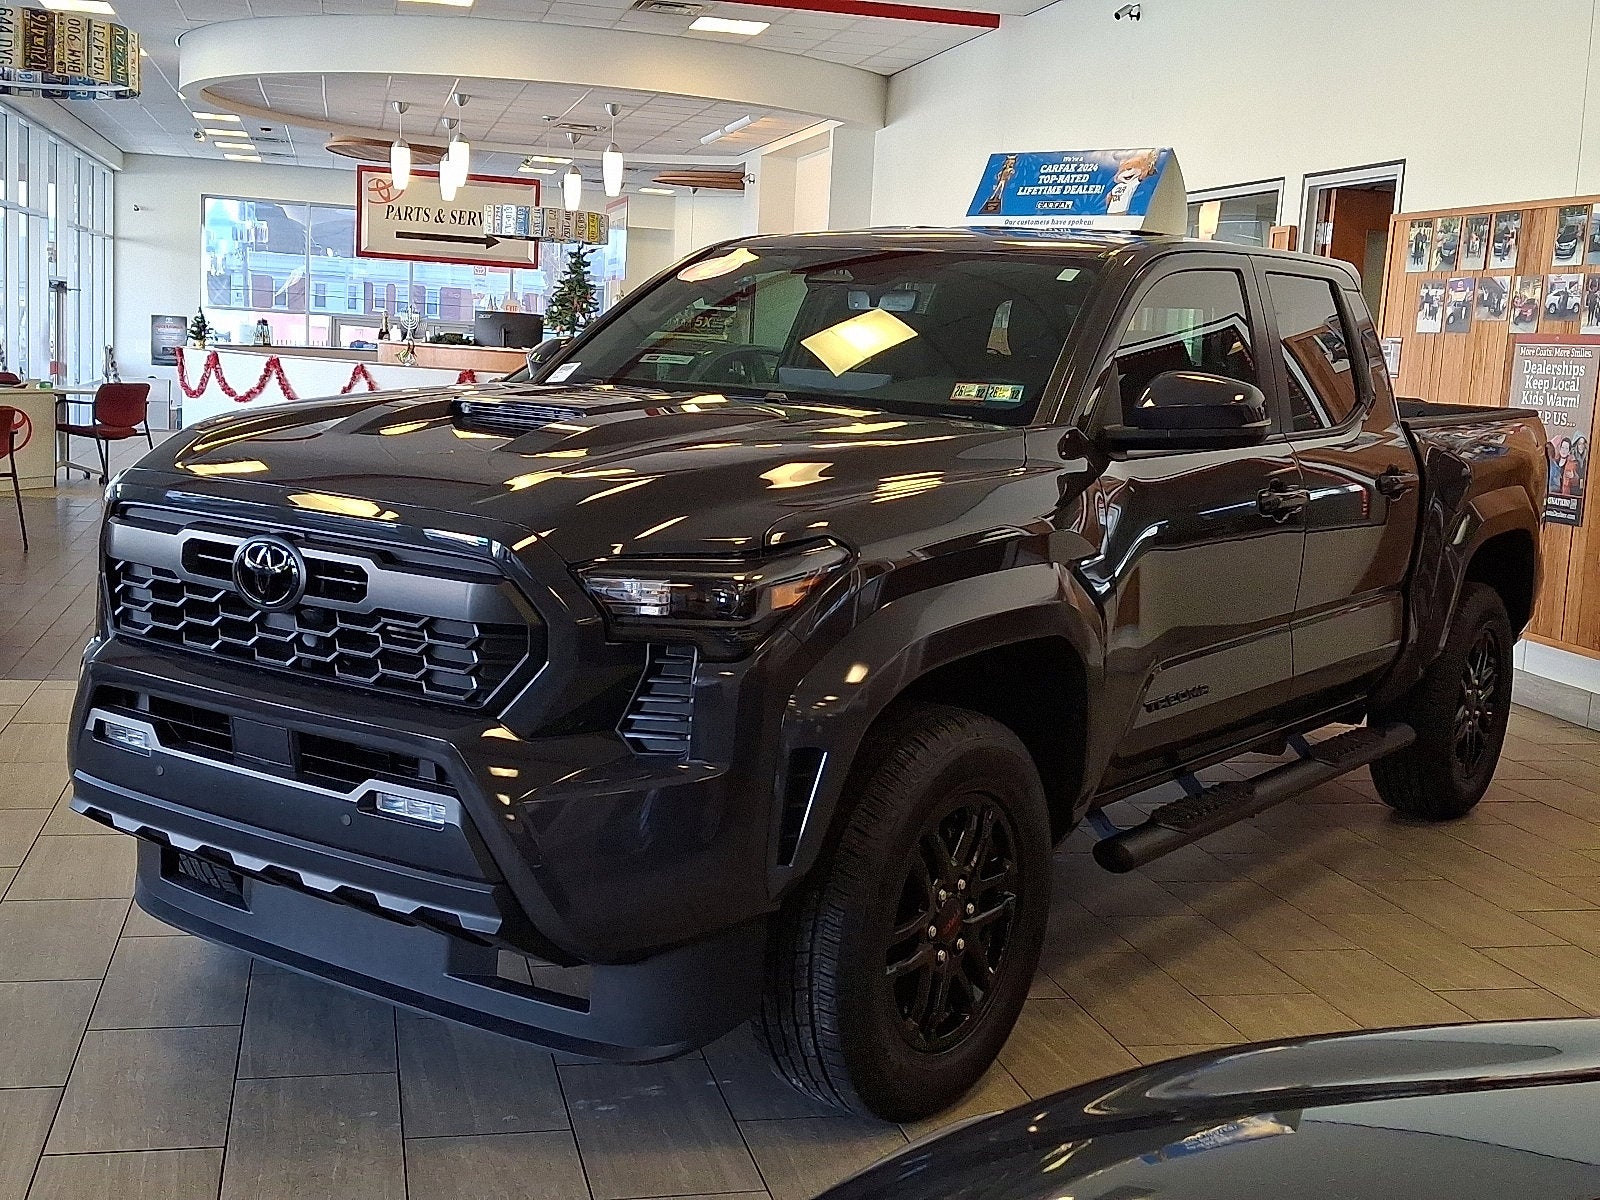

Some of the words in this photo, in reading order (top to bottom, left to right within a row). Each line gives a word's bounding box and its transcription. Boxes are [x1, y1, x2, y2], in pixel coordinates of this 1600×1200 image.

[31, 13, 48, 35] 476
[67, 18, 81, 42] 900
[93, 24, 106, 77] YCA-4731
[67, 48, 81, 73] BKM
[1040, 164, 1077, 173] CARFAX
[1038, 174, 1089, 184] TOP-RATED
[1017, 186, 1063, 196] LIFETIME
[1063, 184, 1106, 195] DEALER!
[385, 205, 431, 222] PARTS
[434, 208, 446, 224] &
[1050, 218, 1067, 226] have
[1519, 347, 1535, 356] More
[1536, 347, 1554, 357] Coats.
[1554, 348, 1571, 357] More
[1571, 348, 1593, 358] Smiles.
[1523, 360, 1586, 379] Dealerships
[1525, 375, 1549, 393] Keep
[1551, 376, 1580, 392] Local
[1521, 391, 1544, 405] Kids
[1546, 392, 1581, 408] Warm!
[1553, 411, 1576, 427] US...
